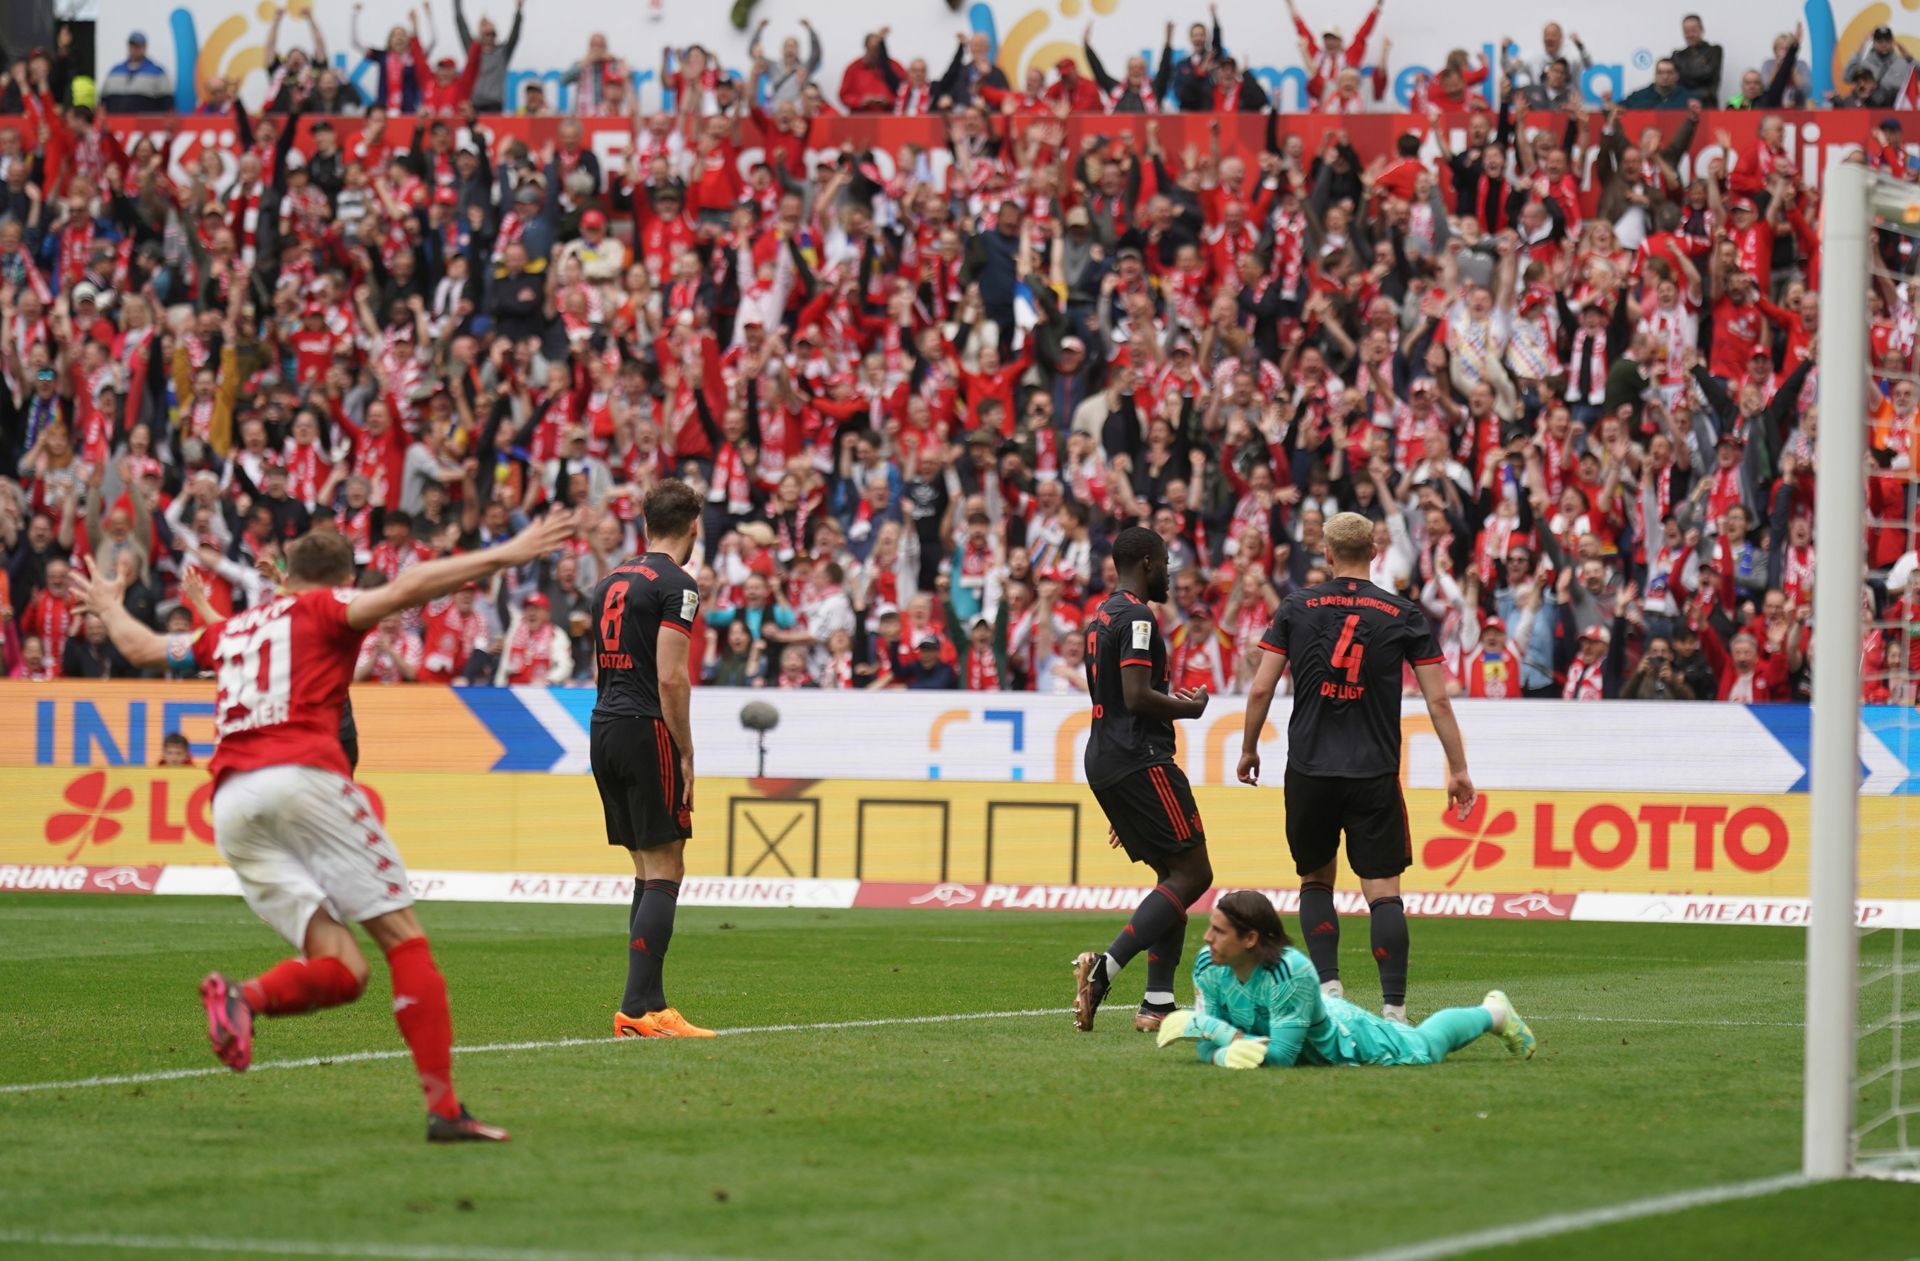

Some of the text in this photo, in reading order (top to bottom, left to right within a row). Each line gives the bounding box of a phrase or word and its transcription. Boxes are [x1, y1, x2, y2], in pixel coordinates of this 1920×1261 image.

[600, 580, 630, 651] 8
[1306, 597, 1319, 608] FC
[1320, 595, 1354, 607] BAYERN
[1330, 614, 1364, 683] 4
[1320, 680, 1365, 700] DE LIGT
[1533, 802, 1790, 872] LOTTO
[509, 877, 796, 903] KATZENHRUNG
